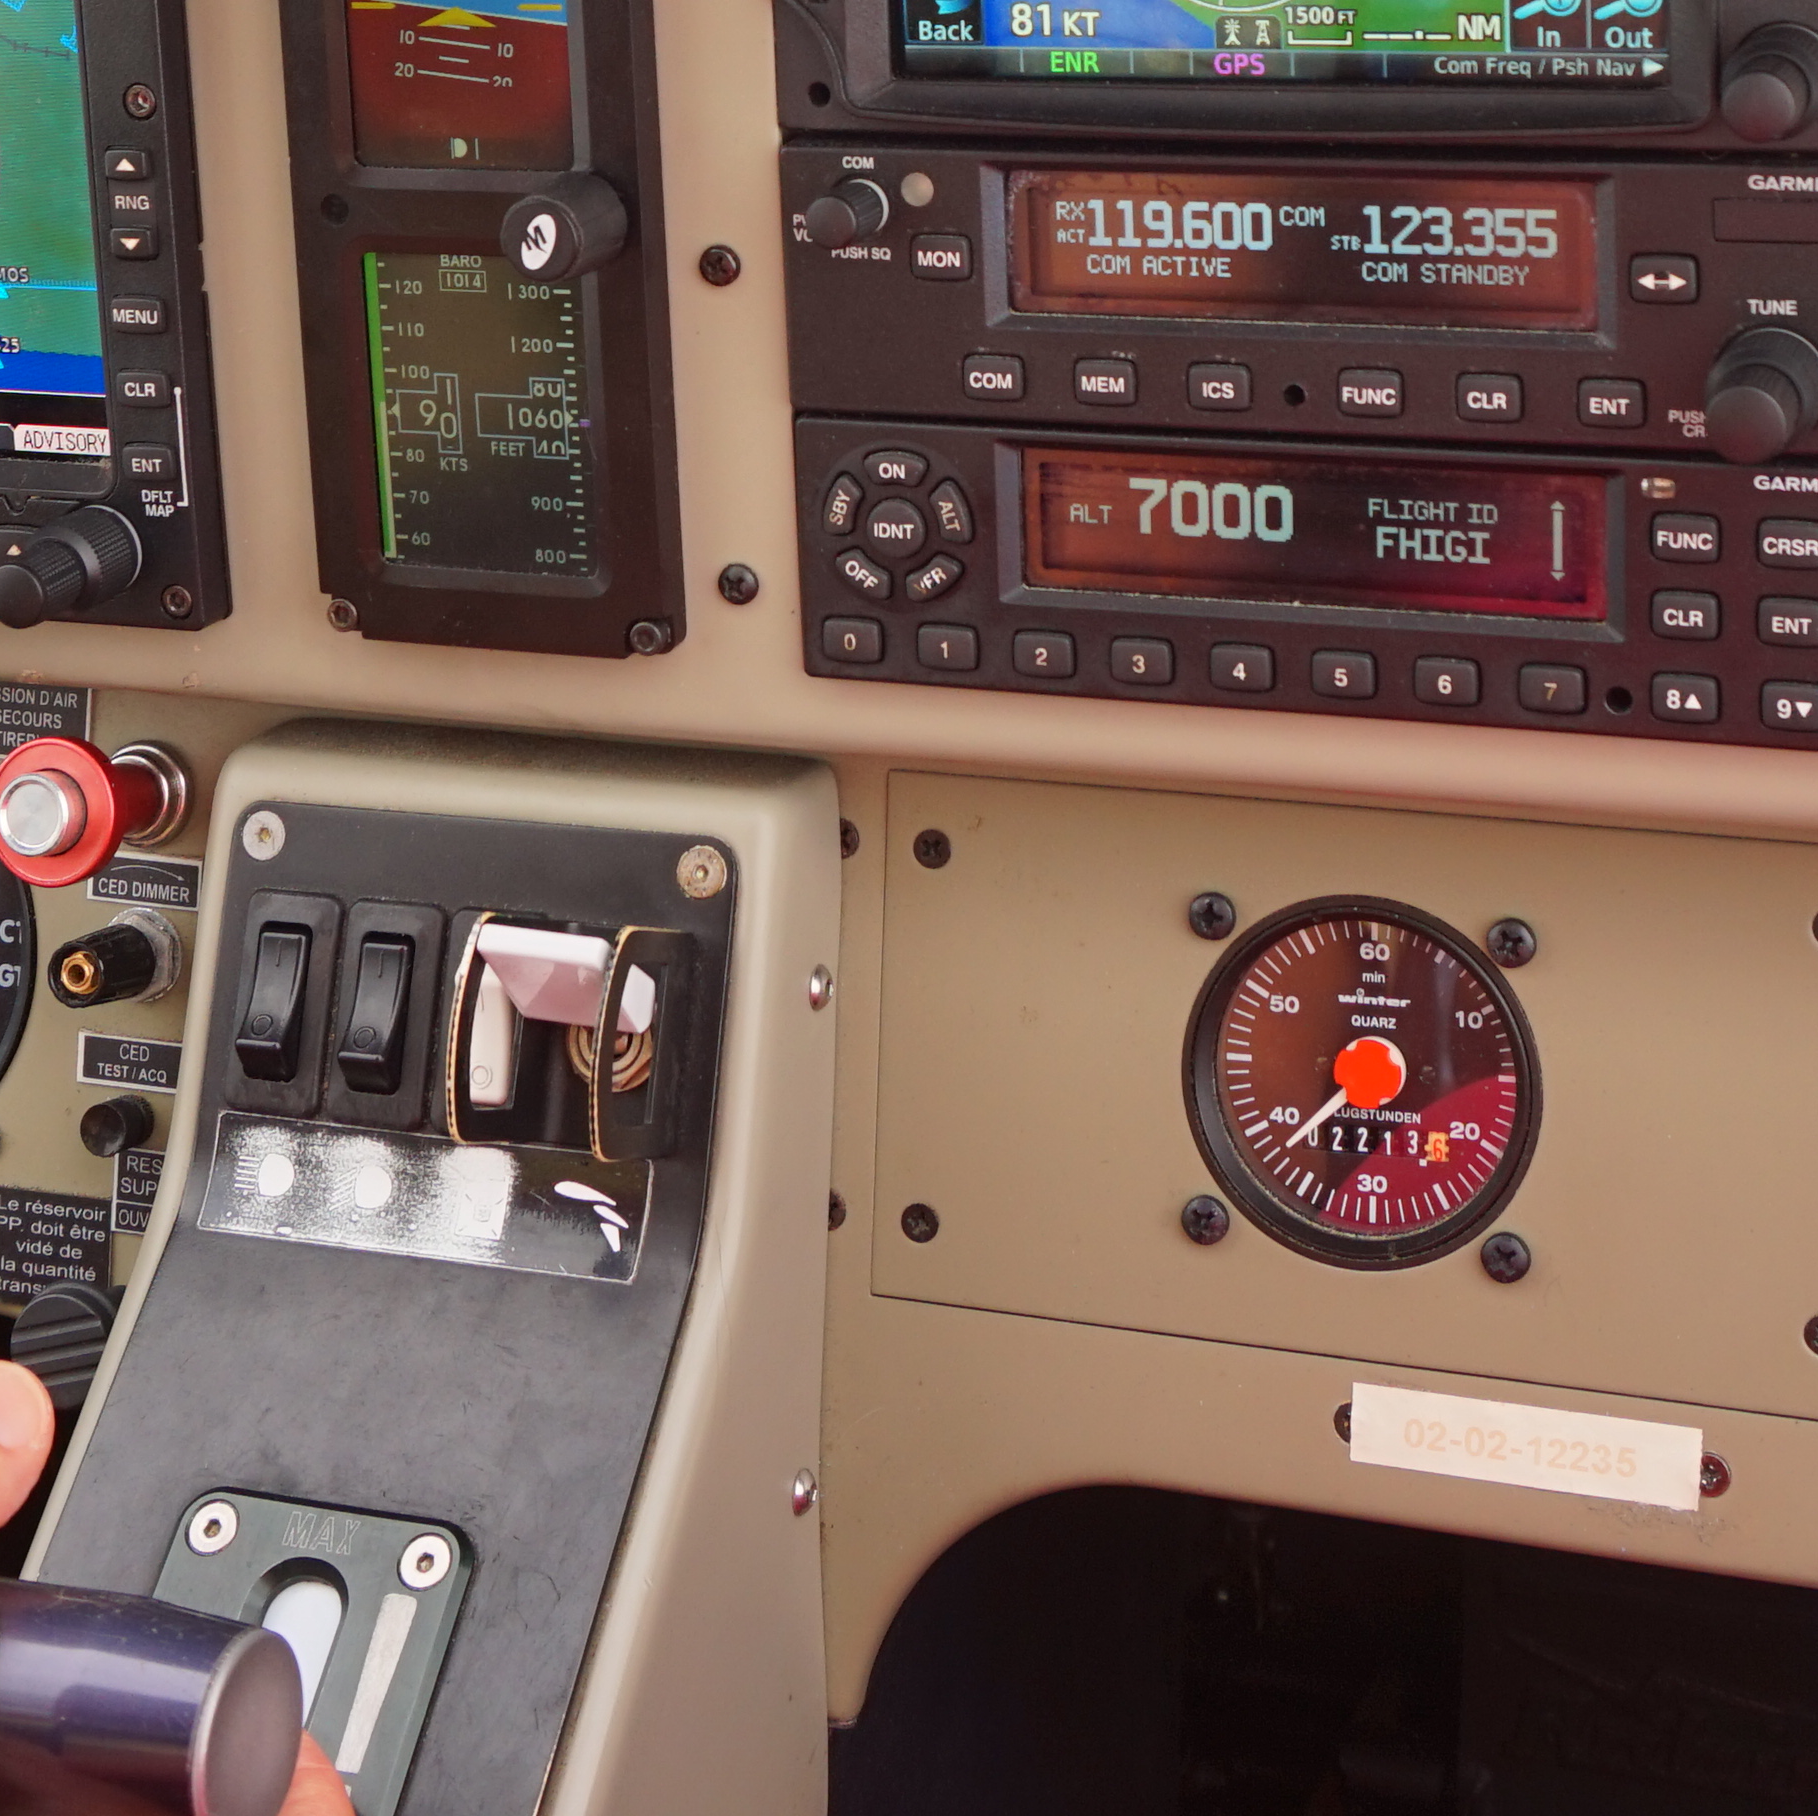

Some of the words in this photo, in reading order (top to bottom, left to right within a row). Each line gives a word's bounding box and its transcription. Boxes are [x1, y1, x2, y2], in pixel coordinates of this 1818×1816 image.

[1011, 3, 1053, 36] 81
[1063, 11, 1101, 36] KT
[919, 21, 973, 41] Back
[115, 195, 150, 210] RNG
[1087, 200, 1273, 251] 119.600
[1363, 206, 1558, 259] 123.355
[440, 255, 481, 267] BARO
[1087, 254, 1132, 275] COM
[1143, 256, 1231, 277] ACTIVE
[1362, 262, 1409, 282] COM
[1420, 264, 1529, 286] STANDBY
[113, 308, 159, 325] MENU
[1748, 299, 1798, 315] TUNE
[1342, 387, 1396, 405] FUNC
[23, 431, 107, 454] ADVISORY
[491, 443, 525, 456] FEET
[1129, 477, 1294, 542] 7000
[1368, 499, 1458, 524] FLIGHT
[1467, 503, 1498, 525] ID
[873, 522, 914, 540] IDNT
[1376, 526, 1491, 564] FHIGI
[1763, 537, 1818, 557] CRSR
[39, 688, 77, 708] D'AIR
[98, 878, 128, 896] CED
[132, 880, 189, 902] DIMMER
[1360, 944, 1390, 961] 60
[1351, 1016, 1396, 1029] QUARZ
[25, 1198, 106, 1222] réservoir
[1404, 1418, 1637, 1478] 02-02-12235
